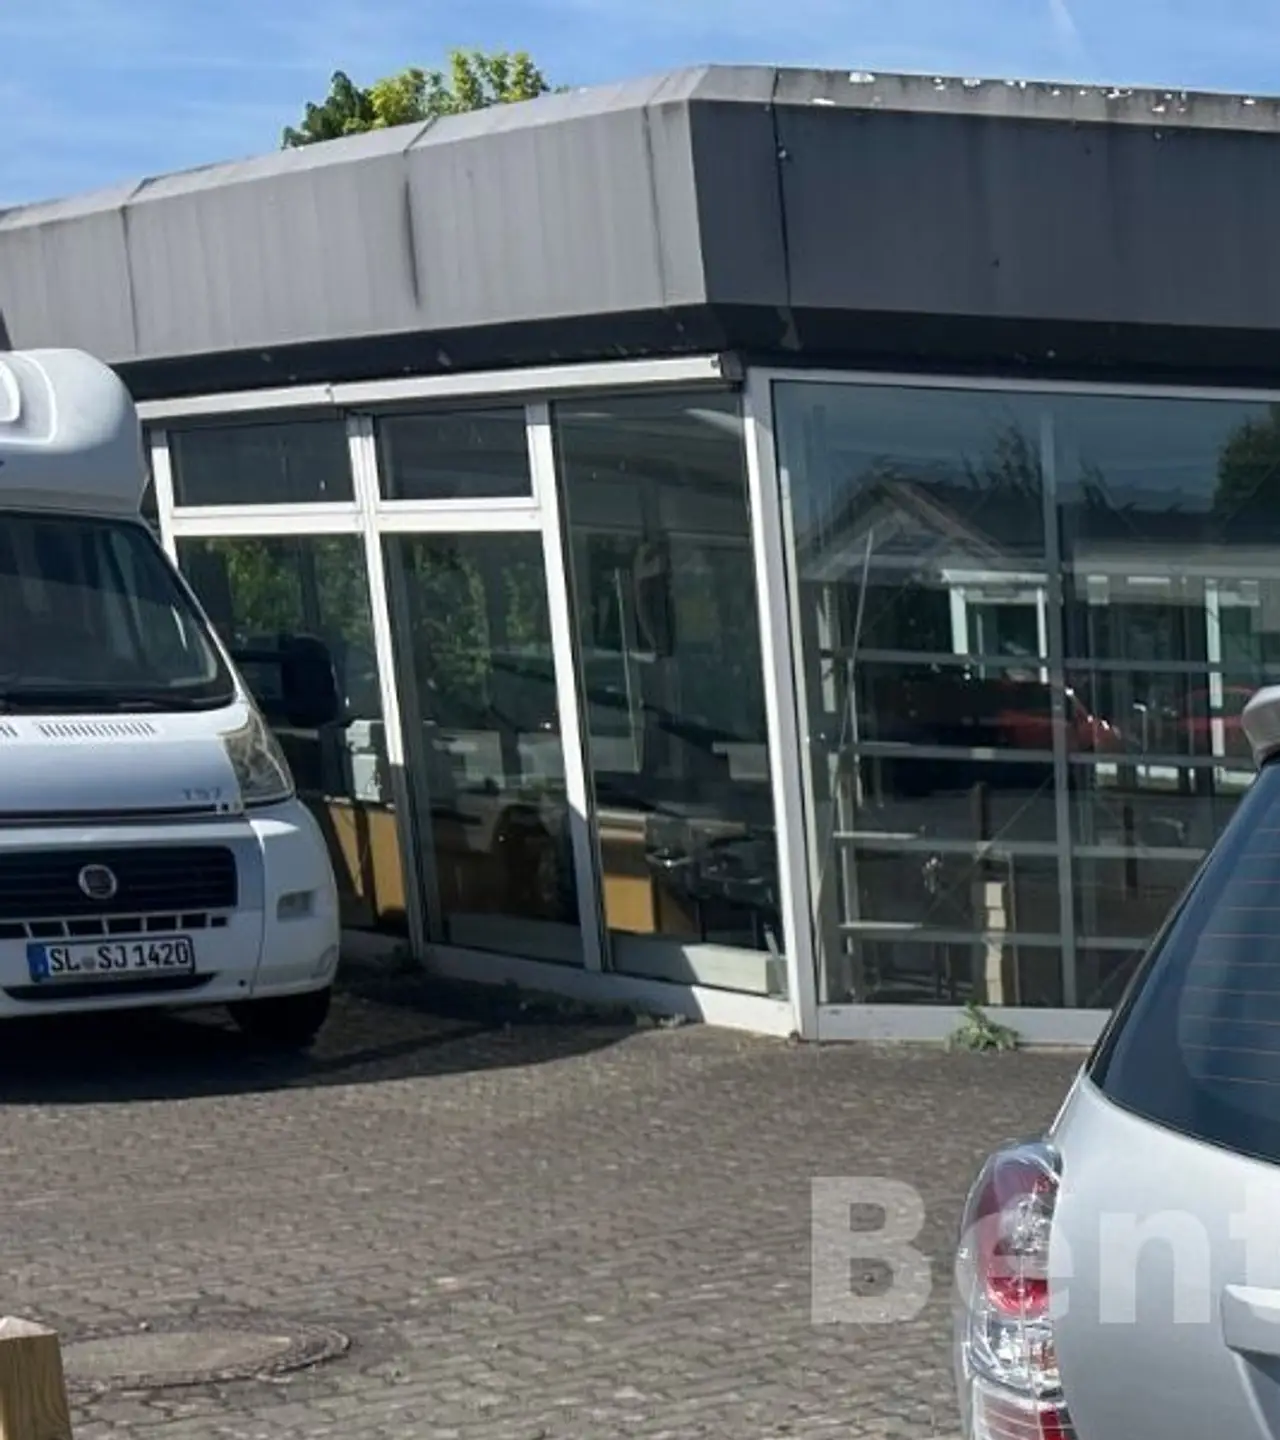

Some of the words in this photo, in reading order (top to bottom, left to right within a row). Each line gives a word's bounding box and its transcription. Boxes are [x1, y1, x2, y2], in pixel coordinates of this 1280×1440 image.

[50, 947, 80, 972] SL
[97, 943, 128, 969] SJ
[134, 940, 190, 967] 1420
